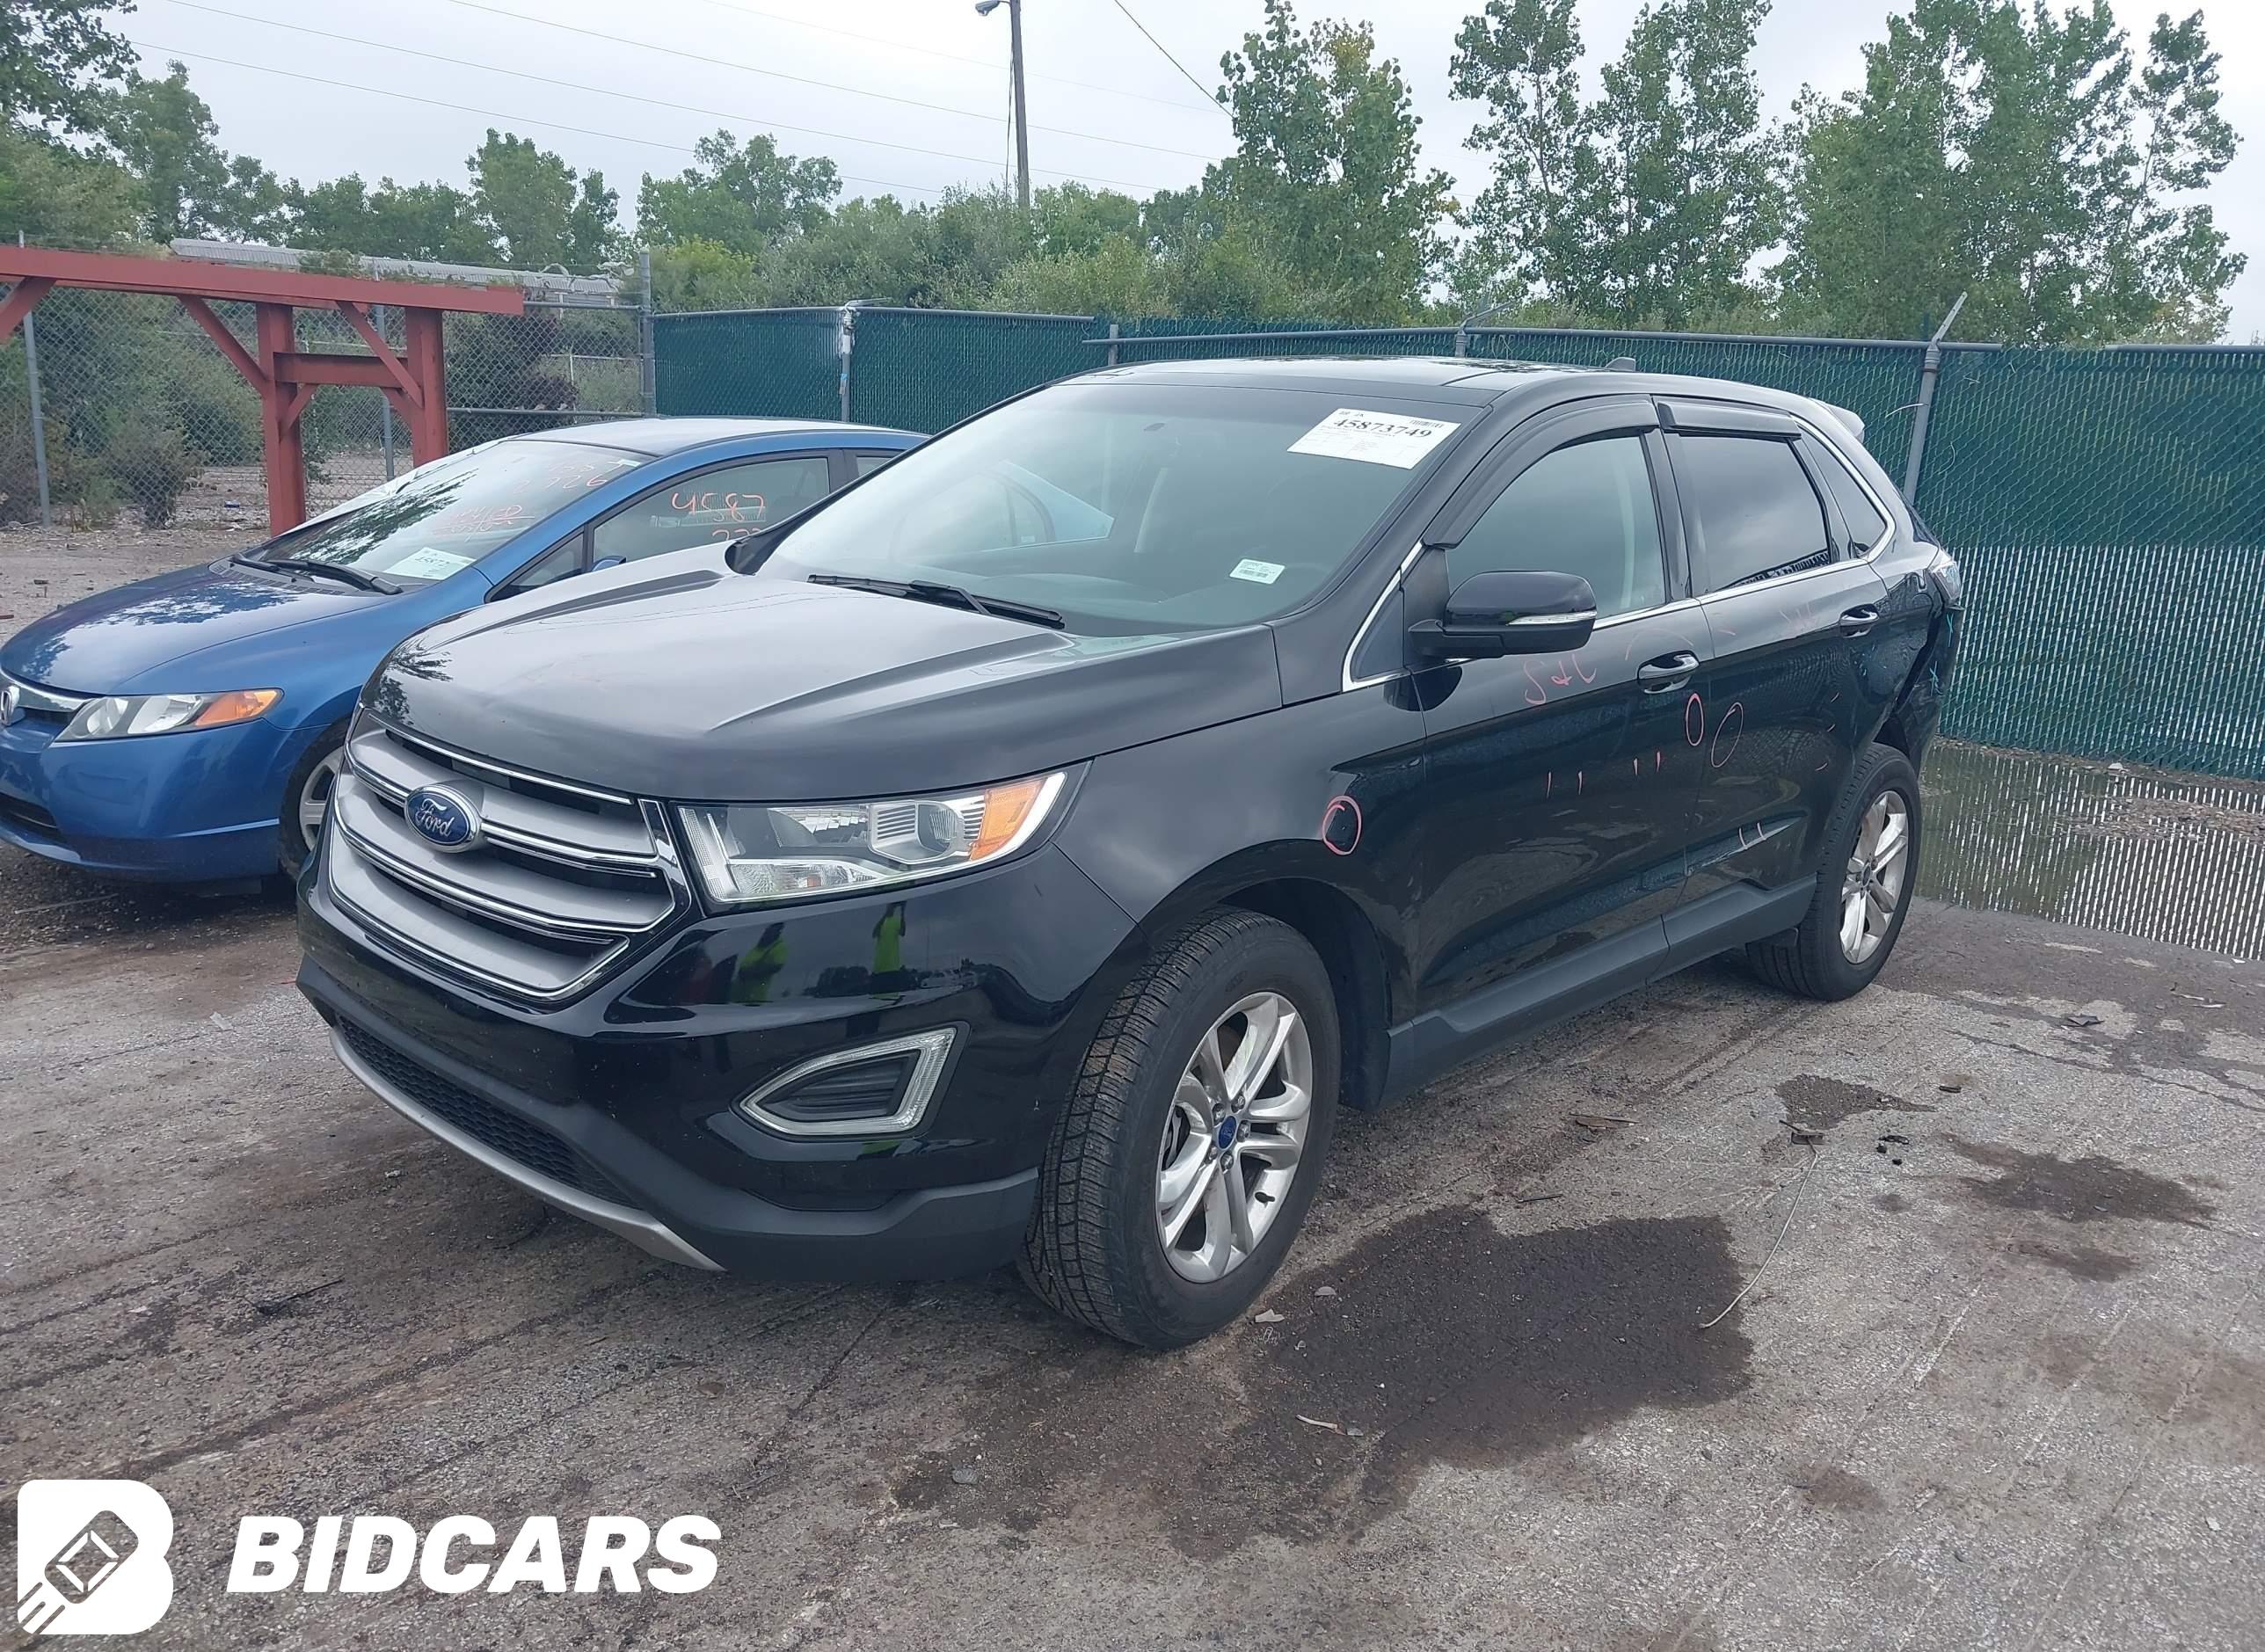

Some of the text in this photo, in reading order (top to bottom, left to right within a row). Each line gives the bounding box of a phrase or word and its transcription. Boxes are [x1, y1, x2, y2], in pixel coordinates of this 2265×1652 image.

[1333, 418, 1432, 439] 45873749
[671, 491, 765, 523] 4587
[415, 797, 455, 838] Ford
